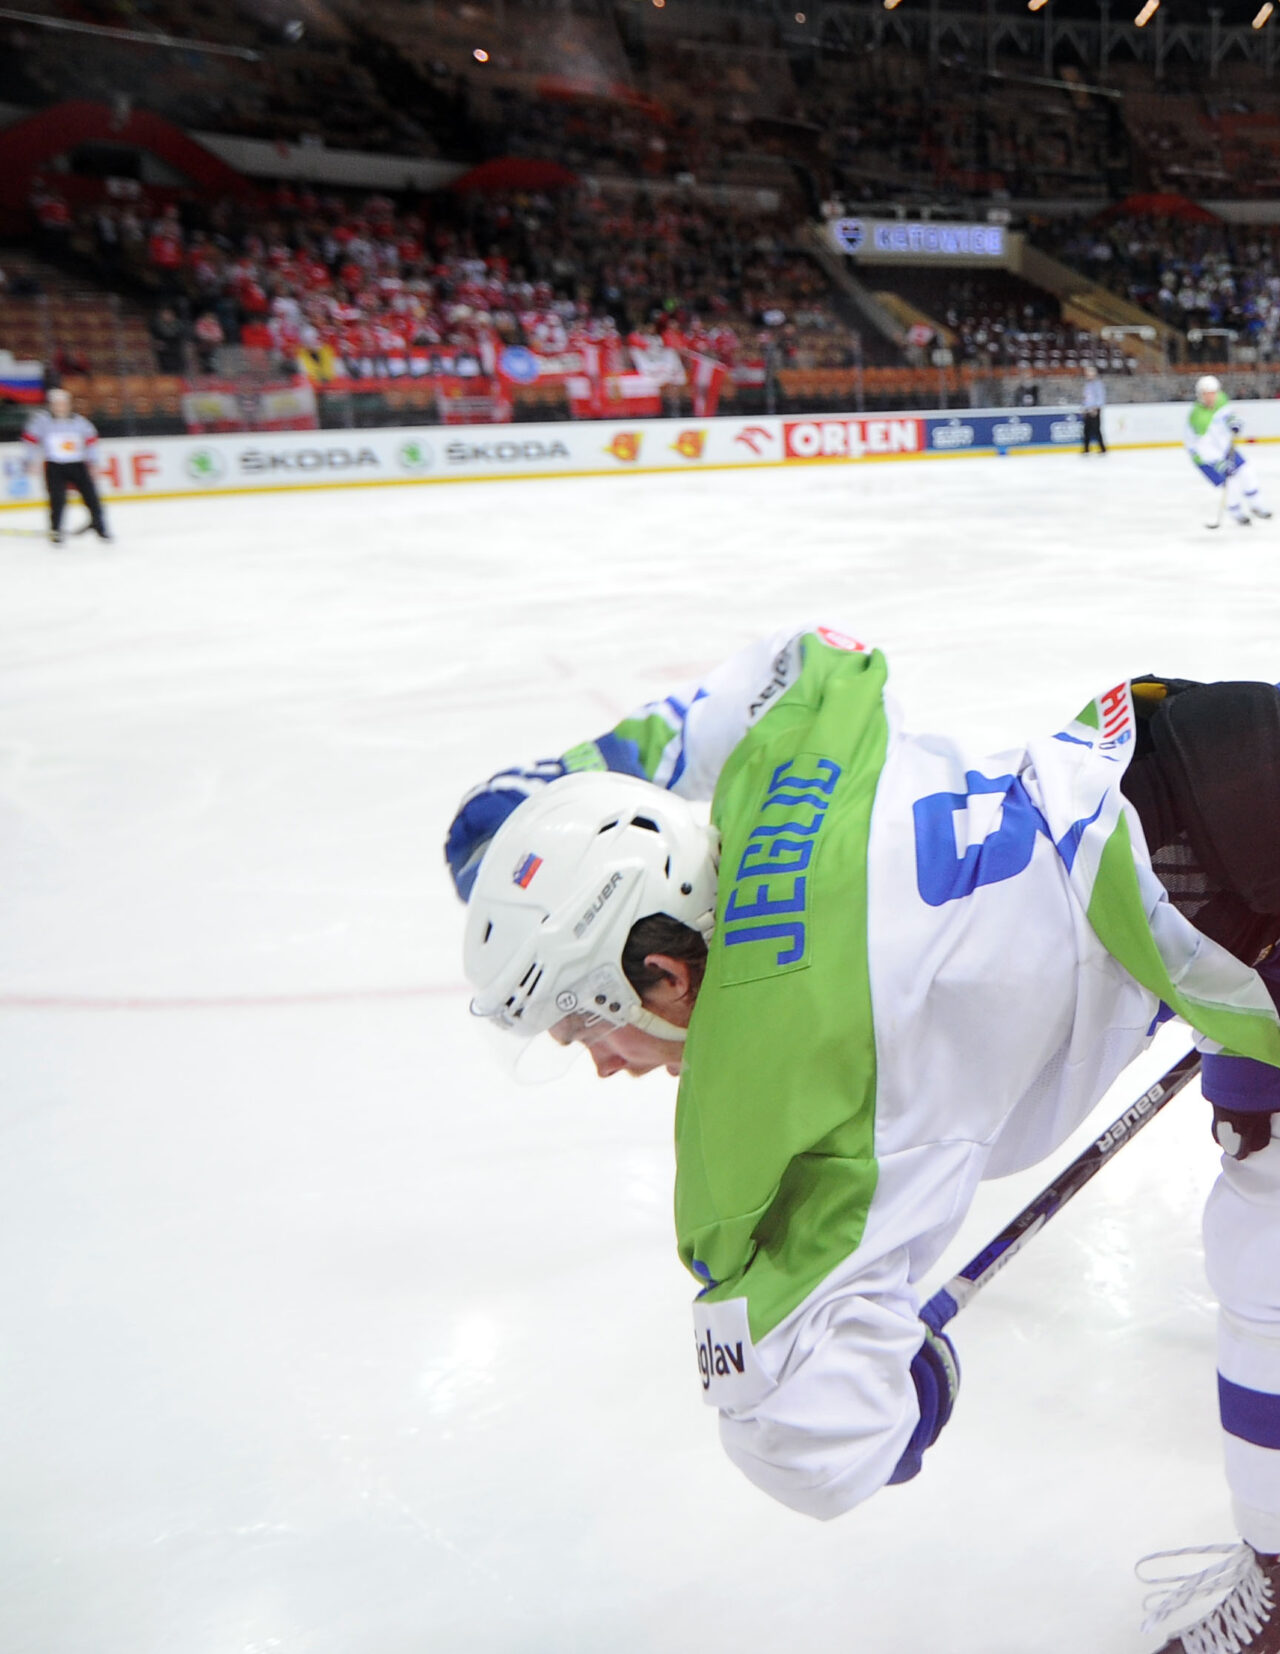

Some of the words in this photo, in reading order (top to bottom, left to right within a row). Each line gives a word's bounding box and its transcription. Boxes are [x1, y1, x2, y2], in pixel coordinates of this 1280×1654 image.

[790, 420, 918, 457] ORLEN
[573, 871, 623, 939] BAUER
[1096, 1082, 1167, 1153] BAUER
[695, 1329, 745, 1391] glav
